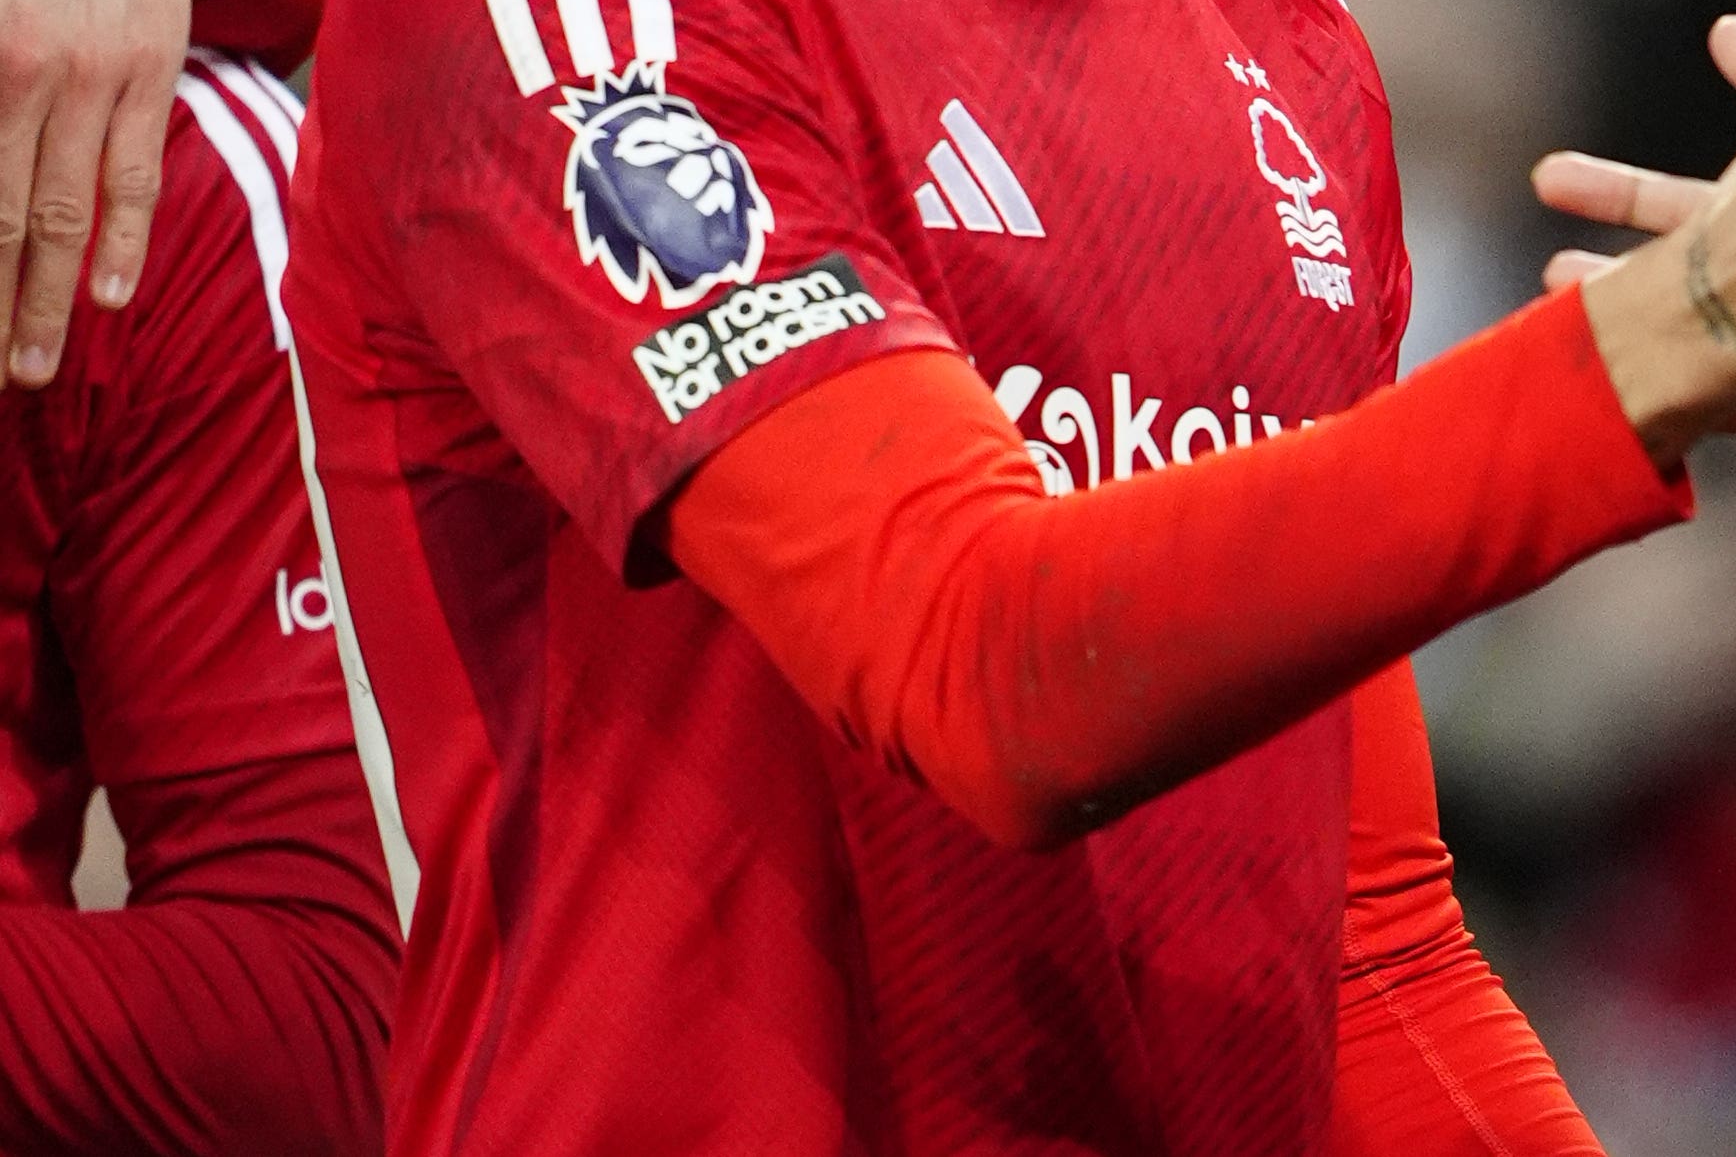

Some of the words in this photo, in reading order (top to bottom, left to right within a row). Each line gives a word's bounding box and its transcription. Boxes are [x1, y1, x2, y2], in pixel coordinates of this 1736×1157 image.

[632, 322, 710, 390] No
[706, 270, 846, 342] room
[650, 352, 723, 425] for
[721, 291, 886, 378] racism
